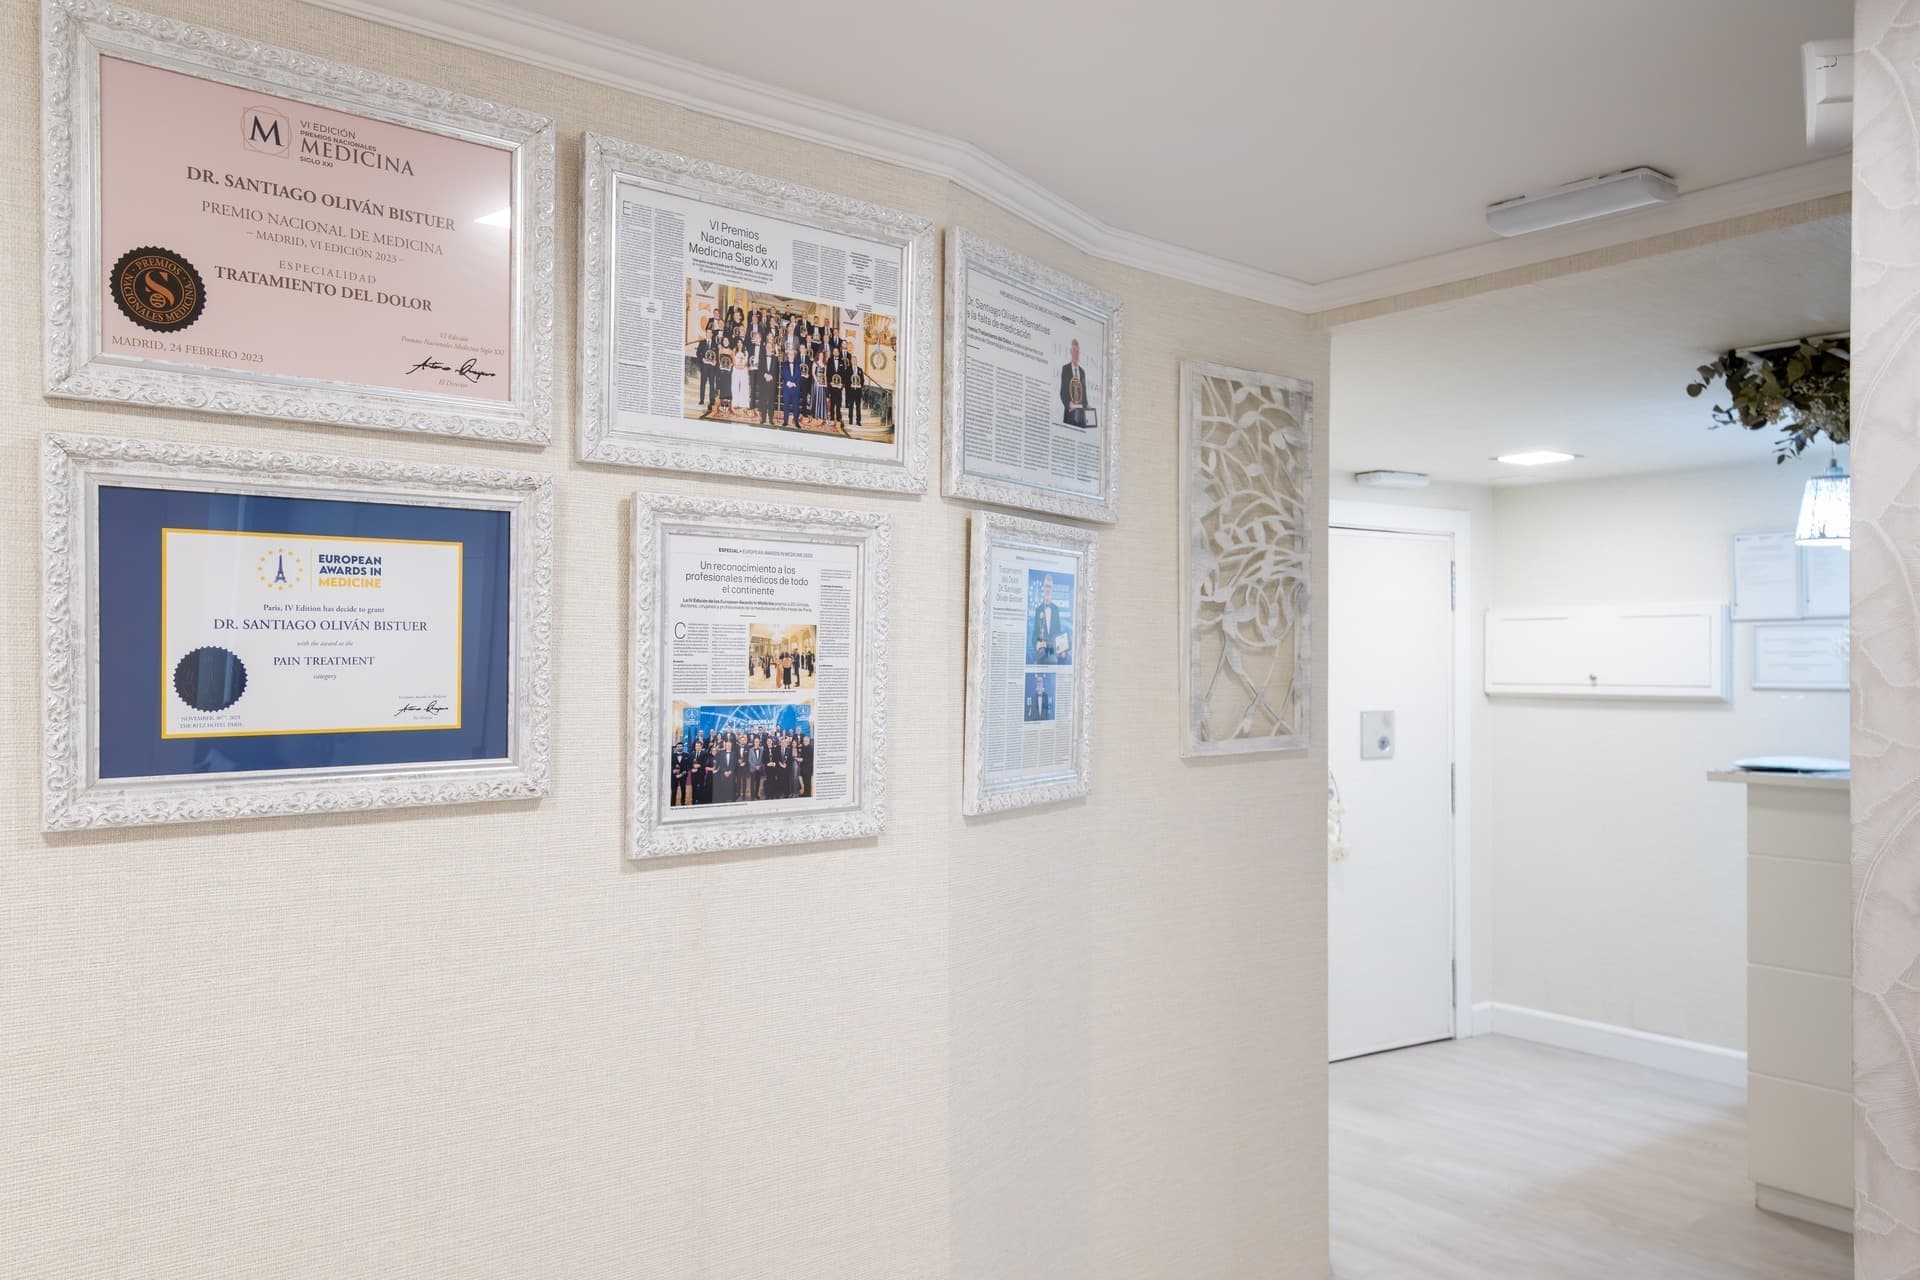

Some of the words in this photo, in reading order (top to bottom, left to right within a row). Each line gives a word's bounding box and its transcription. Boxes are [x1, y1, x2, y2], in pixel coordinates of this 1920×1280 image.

[249, 115, 285, 147] M
[300, 120, 310, 129] VI
[313, 122, 356, 140] EDICIÓN
[300, 130, 332, 142] PREMIOS
[333, 138, 377, 152] NACIONALES
[300, 156, 321, 166] SIGLO
[322, 160, 334, 168] XXI
[301, 137, 414, 177] MEDICINA
[186, 166, 219, 185] DR.
[224, 174, 316, 204] SANTIAGO
[321, 194, 384, 217] OLIVÁN
[389, 206, 455, 232] BISTUER
[202, 200, 263, 222] PREMIO
[267, 212, 346, 238] NACIONAL
[350, 227, 370, 242] DE
[373, 233, 443, 256] MEDICINA
[709, 218, 720, 232] VI
[721, 222, 760, 240] Premios
[310, 239, 322, 250] VI
[324, 242, 373, 259] EDICIÓN
[375, 251, 397, 264] 2023
[701, 231, 754, 253] Nacionales
[755, 243, 768, 255] de
[135, 256, 182, 276] PREMIOS
[689, 241, 733, 261] Medicina
[735, 251, 759, 267] Siglo
[761, 258, 778, 271] XXI
[279, 259, 377, 284] ESPECIALIDAD
[122, 274, 164, 322] NACIONALES
[165, 280, 195, 322] MEDICINA
[213, 265, 337, 297] TRATAMIENTO
[341, 286, 374, 303] DEL
[377, 291, 432, 312] DOLOR
[111, 335, 167, 352] MADRID,
[169, 342, 182, 353] 24
[185, 344, 238, 361] FEBRERO
[240, 351, 264, 364] 2023
[318, 554, 382, 566] EUROPEAN
[700, 560, 712, 570] Un
[713, 561, 776, 574] reconocimiento
[777, 566, 783, 574] a
[784, 565, 796, 575] los
[319, 565, 367, 576] AWARDS
[370, 566, 382, 577] IN
[685, 572, 742, 584] profesionales
[744, 574, 778, 585] médicos
[779, 576, 789, 586] de
[791, 577, 809, 586] todo
[318, 577, 382, 589] MEDICINE
[722, 585, 730, 594] el
[731, 585, 775, 596] continente
[284, 604, 294, 612] IV
[295, 604, 321, 613] Edition
[323, 604, 335, 613] has
[359, 605, 366, 614] to
[367, 606, 385, 615] grant
[213, 618, 239, 630] DR.
[243, 619, 316, 631] SANTIAGO
[320, 618, 370, 632] OLIVÁN
[374, 620, 428, 632] BISTUER
[674, 621, 686, 640] C
[273, 656, 301, 666] PAIN
[304, 656, 376, 666] TREATMENT
